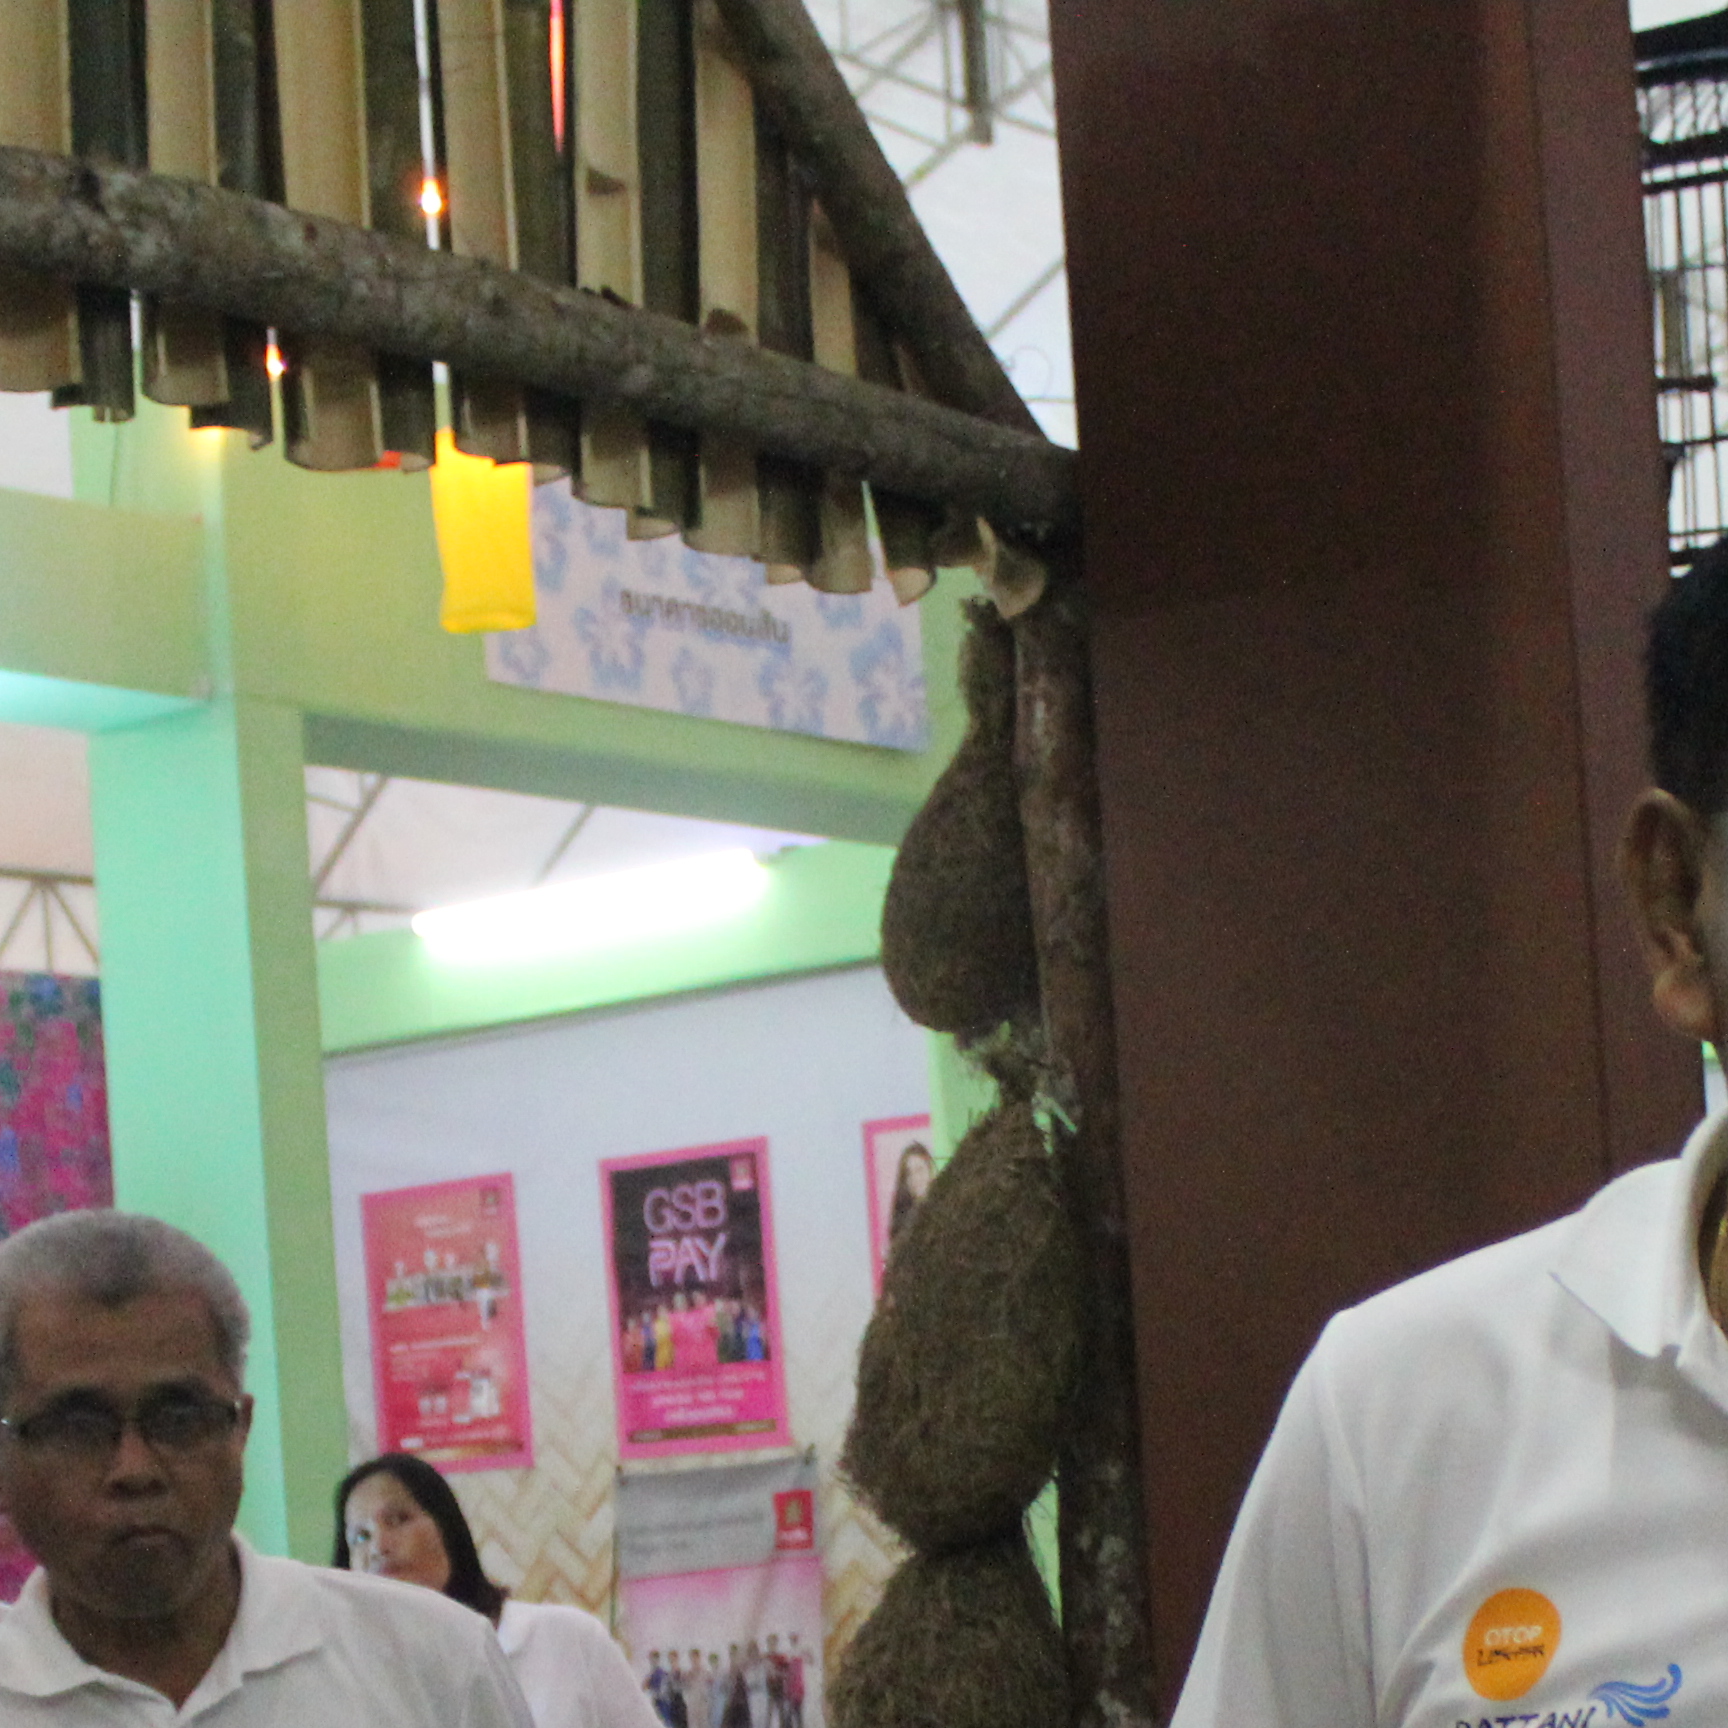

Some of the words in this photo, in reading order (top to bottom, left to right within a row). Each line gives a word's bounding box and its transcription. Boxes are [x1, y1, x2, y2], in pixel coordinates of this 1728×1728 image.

[643, 1179, 727, 1235] GSB
[648, 1231, 729, 1287] PAY
[1483, 1625, 1544, 1647] OTOP
